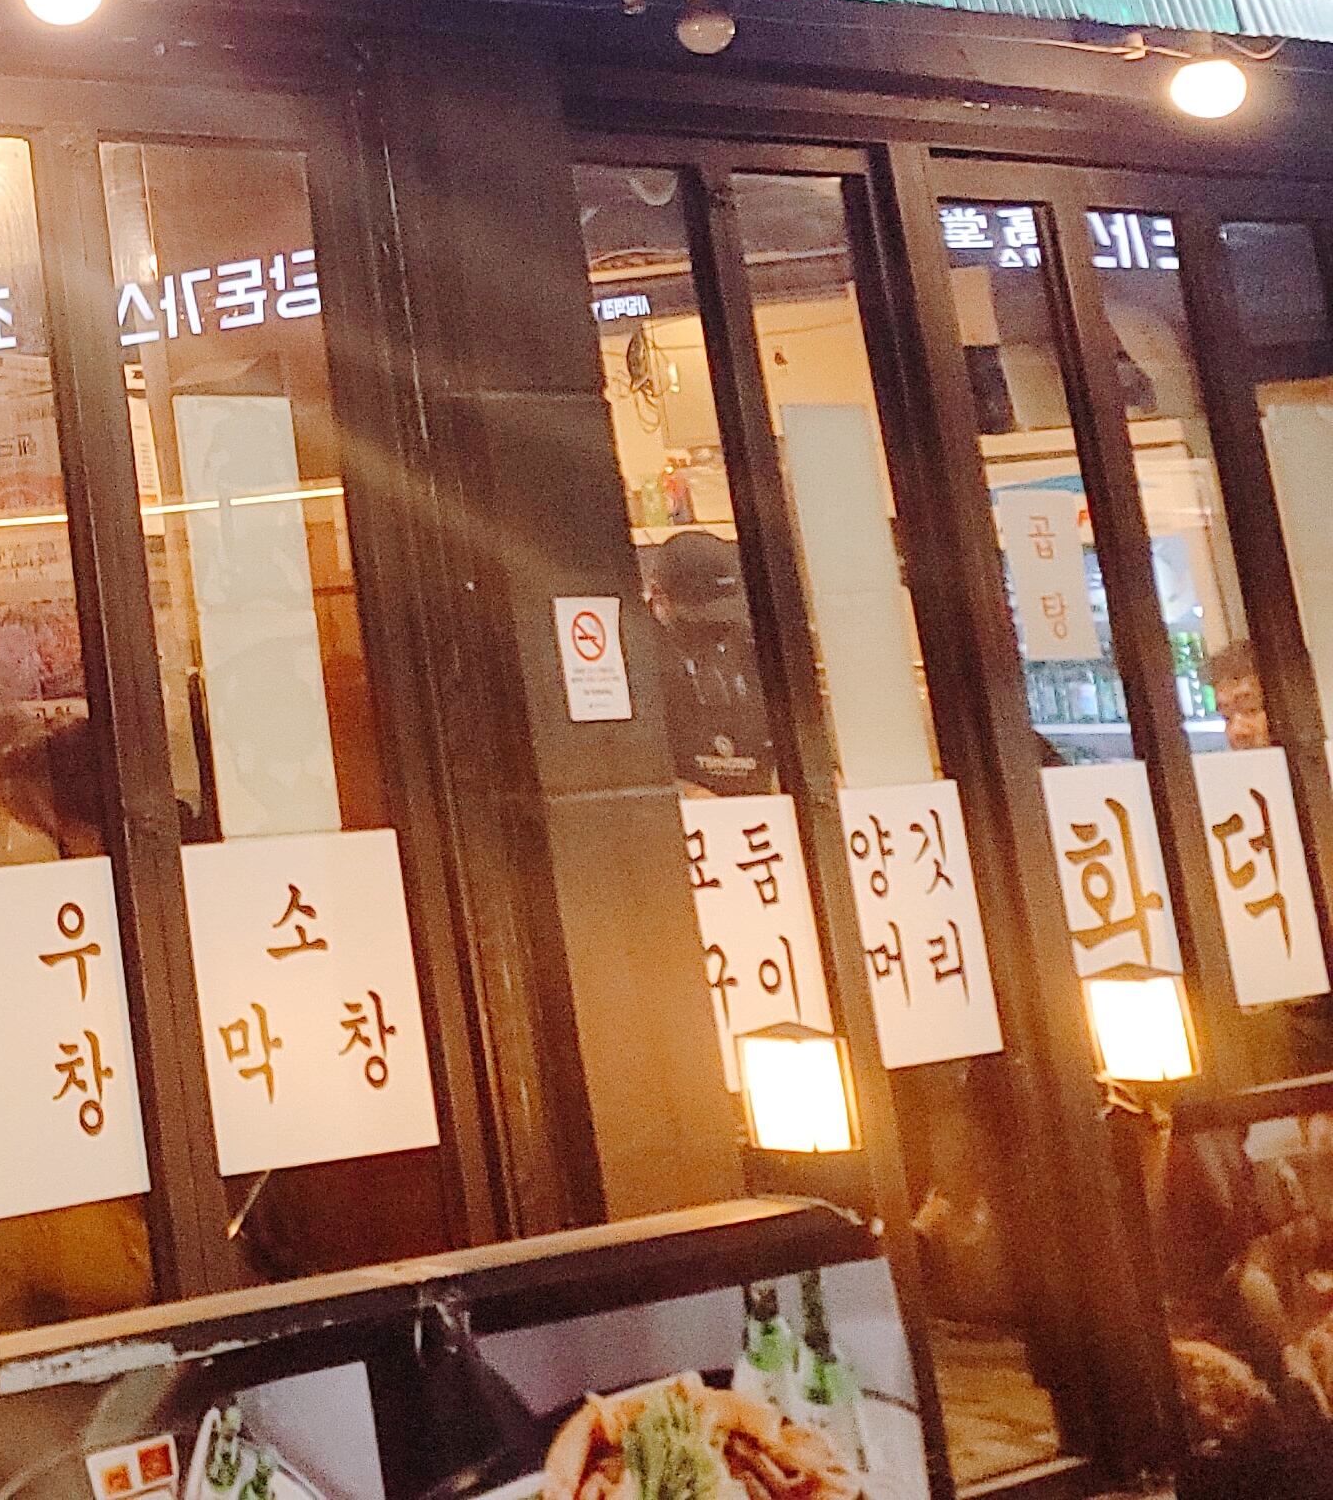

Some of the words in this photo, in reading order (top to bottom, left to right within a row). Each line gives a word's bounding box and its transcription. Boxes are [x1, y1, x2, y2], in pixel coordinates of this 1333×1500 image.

[686, 822, 783, 905] 모둠
[850, 809, 954, 898] 양깃
[266, 883, 329, 961] 소
[865, 919, 971, 1007] 머리
[219, 990, 397, 1104] 막창
